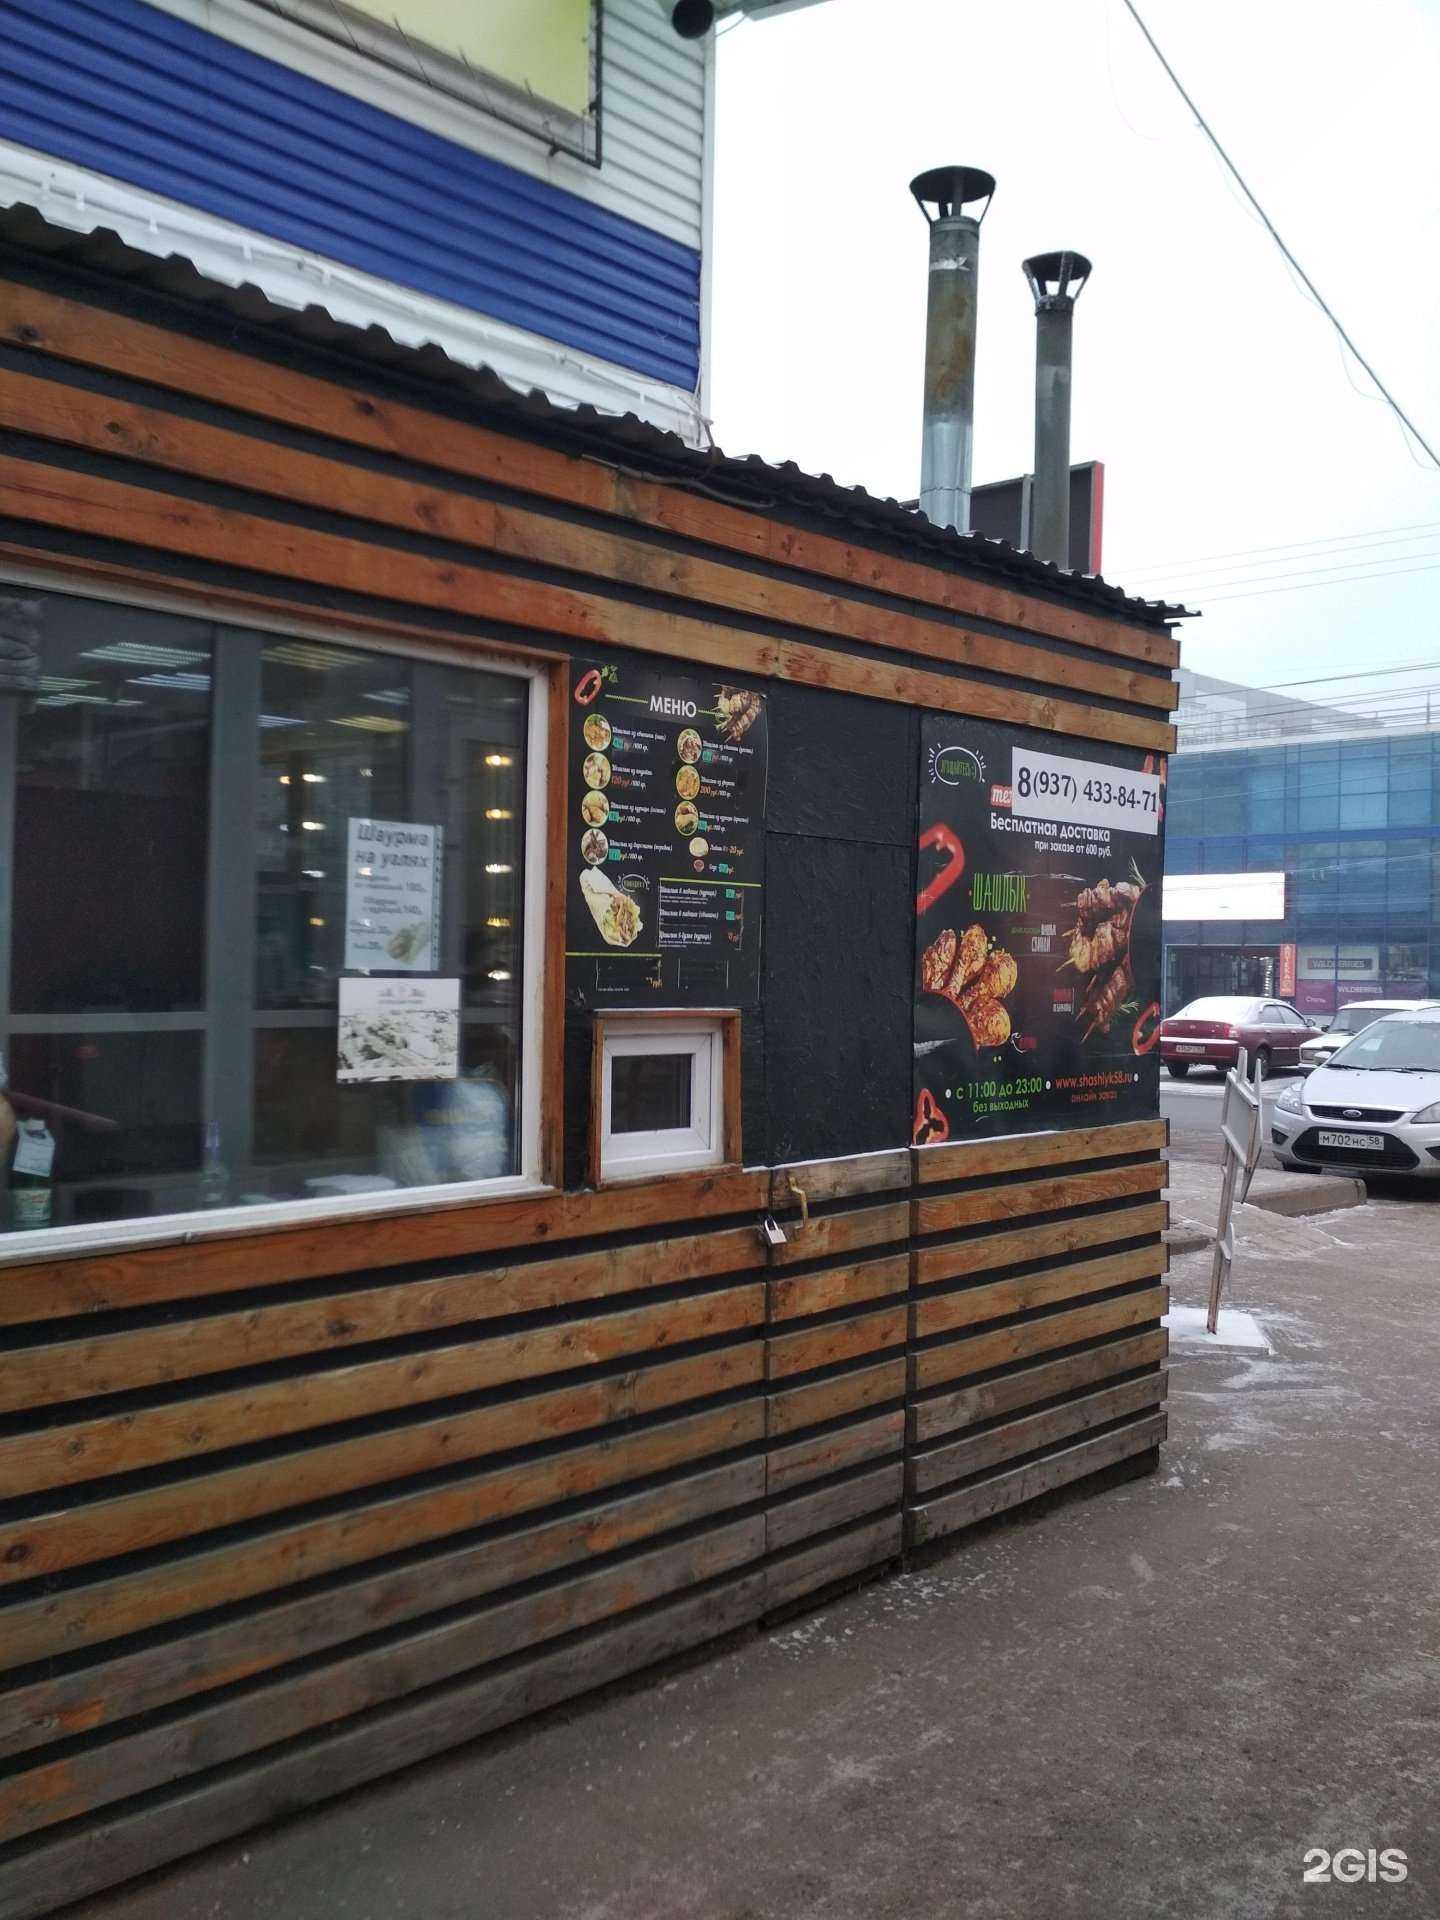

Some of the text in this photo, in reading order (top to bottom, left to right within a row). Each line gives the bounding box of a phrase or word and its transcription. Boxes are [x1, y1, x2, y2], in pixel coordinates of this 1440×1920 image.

[649, 695, 697, 718] МЕНЮ
[1017, 766, 1158, 814] 8(937) 433-84-71
[357, 823, 429, 848] Шаурма
[991, 811, 1111, 843] Бесплатная доставка
[354, 851, 376, 864] на
[1034, 840, 1112, 858] при заказе от 600 руб.
[969, 1081, 996, 1099] 11:00
[999, 1083, 1013, 1097] до
[1016, 1077, 1042, 1095] 23:00
[973, 1098, 1029, 1113] без выходных
